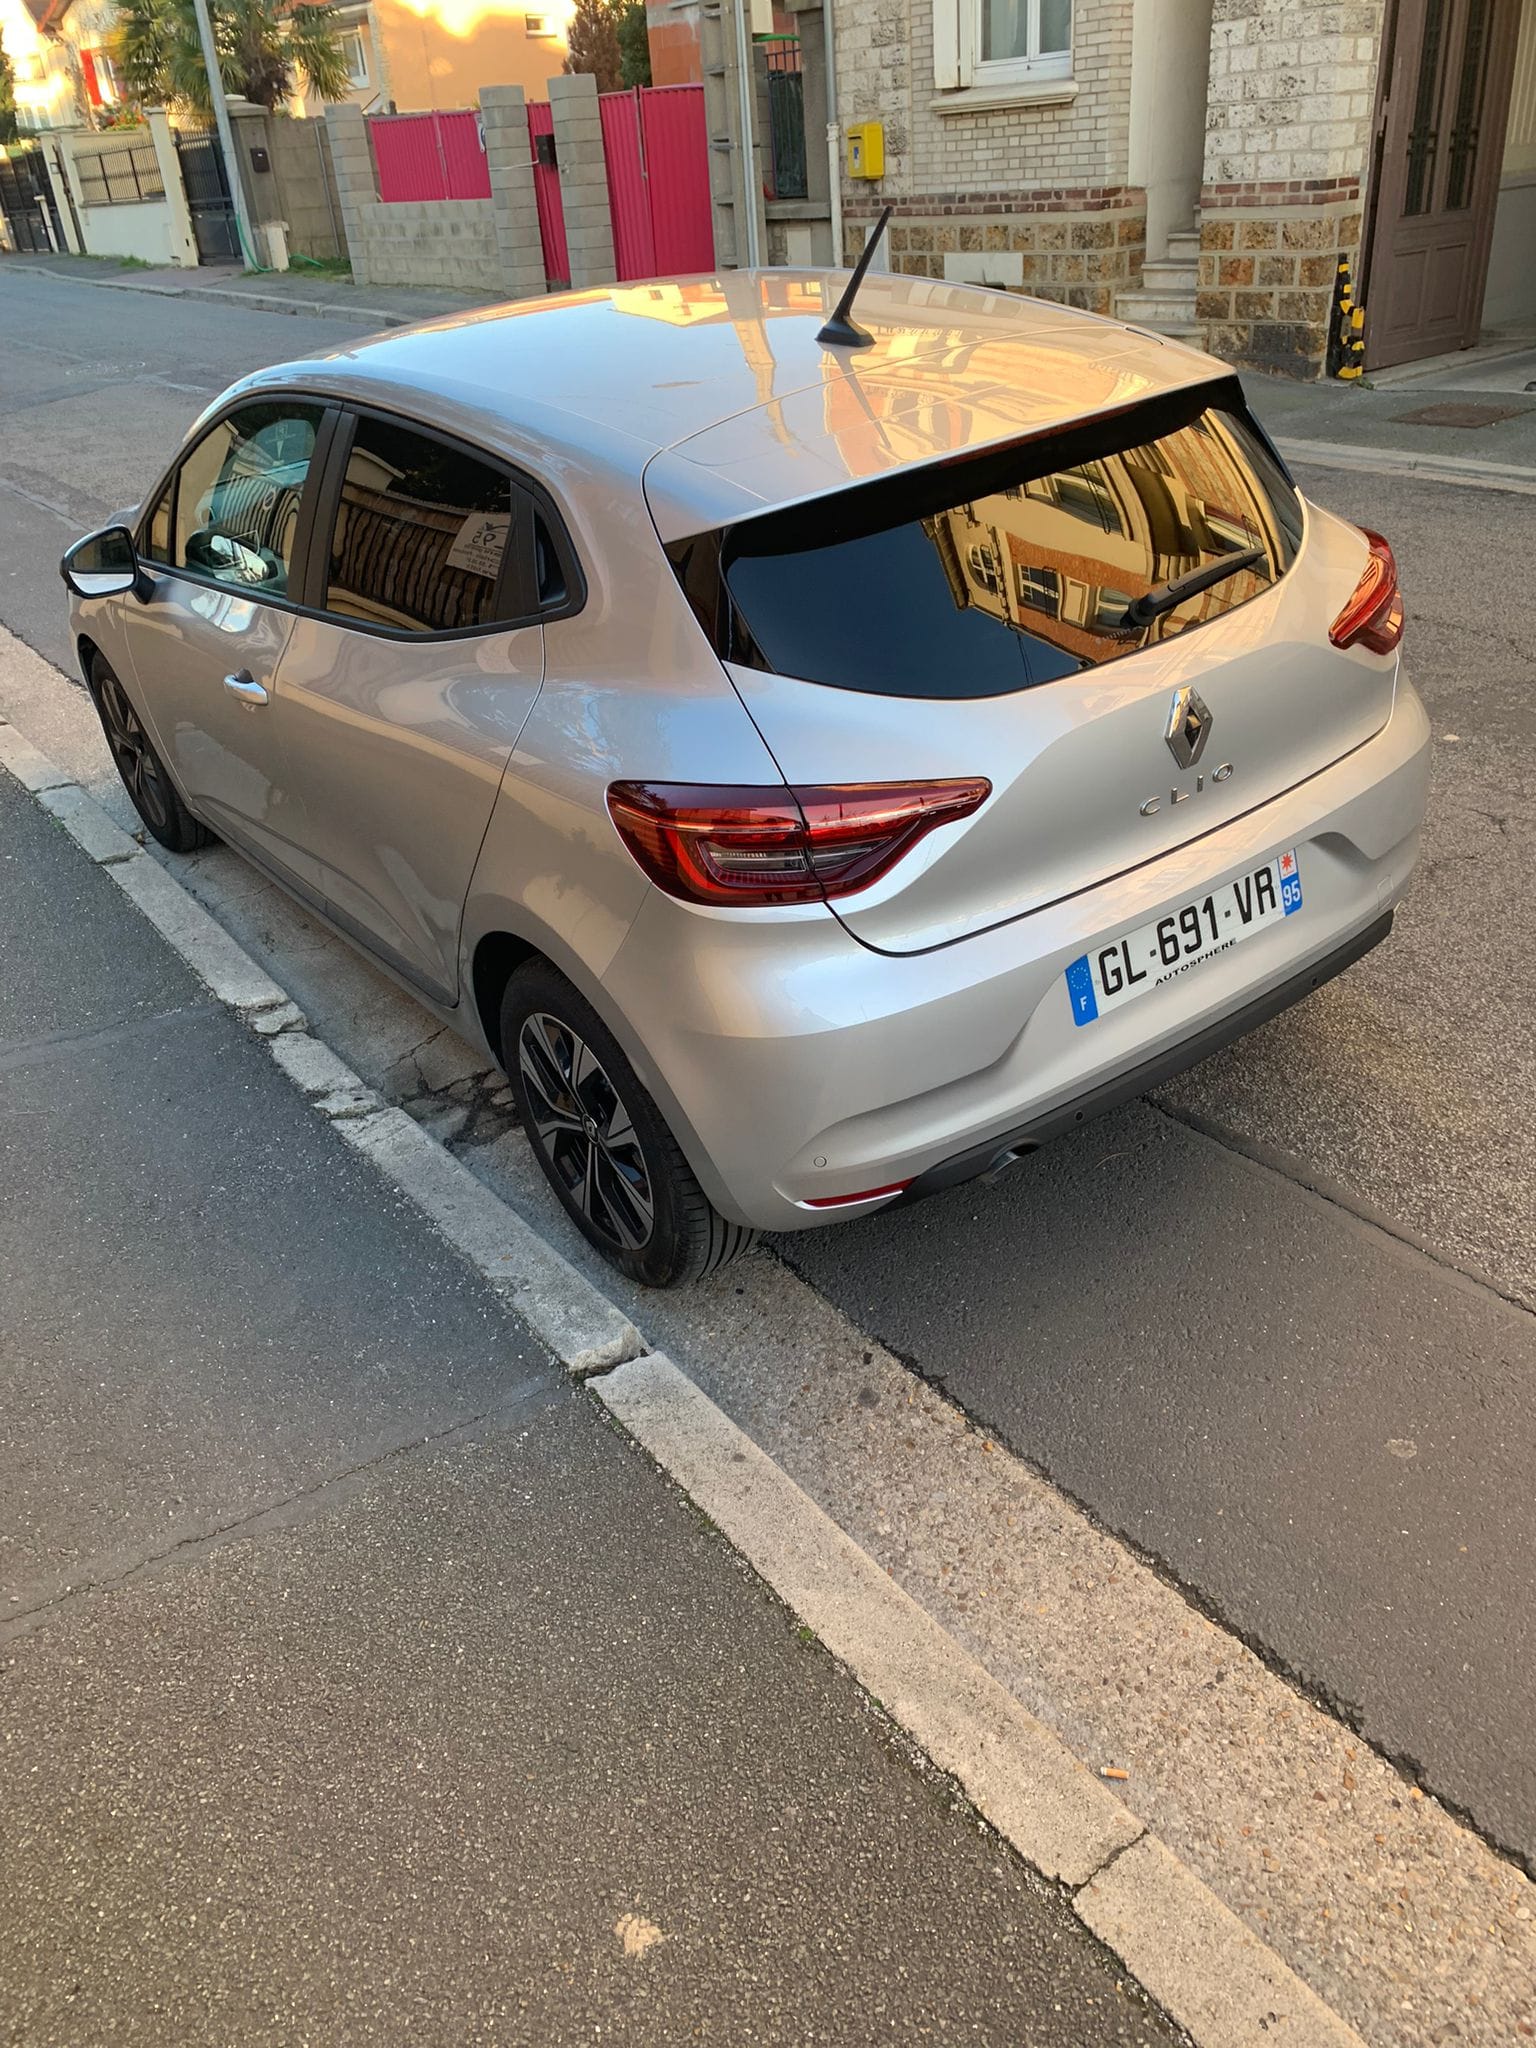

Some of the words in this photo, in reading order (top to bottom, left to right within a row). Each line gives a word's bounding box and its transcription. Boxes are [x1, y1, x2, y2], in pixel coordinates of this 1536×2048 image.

[1140, 763, 1233, 816] CLIO
[1283, 880, 1301, 906] 95
[1098, 866, 1276, 996] GL-691-VR
[1155, 937, 1237, 986] AUTOSPHERE
[1080, 996, 1088, 1010] F
